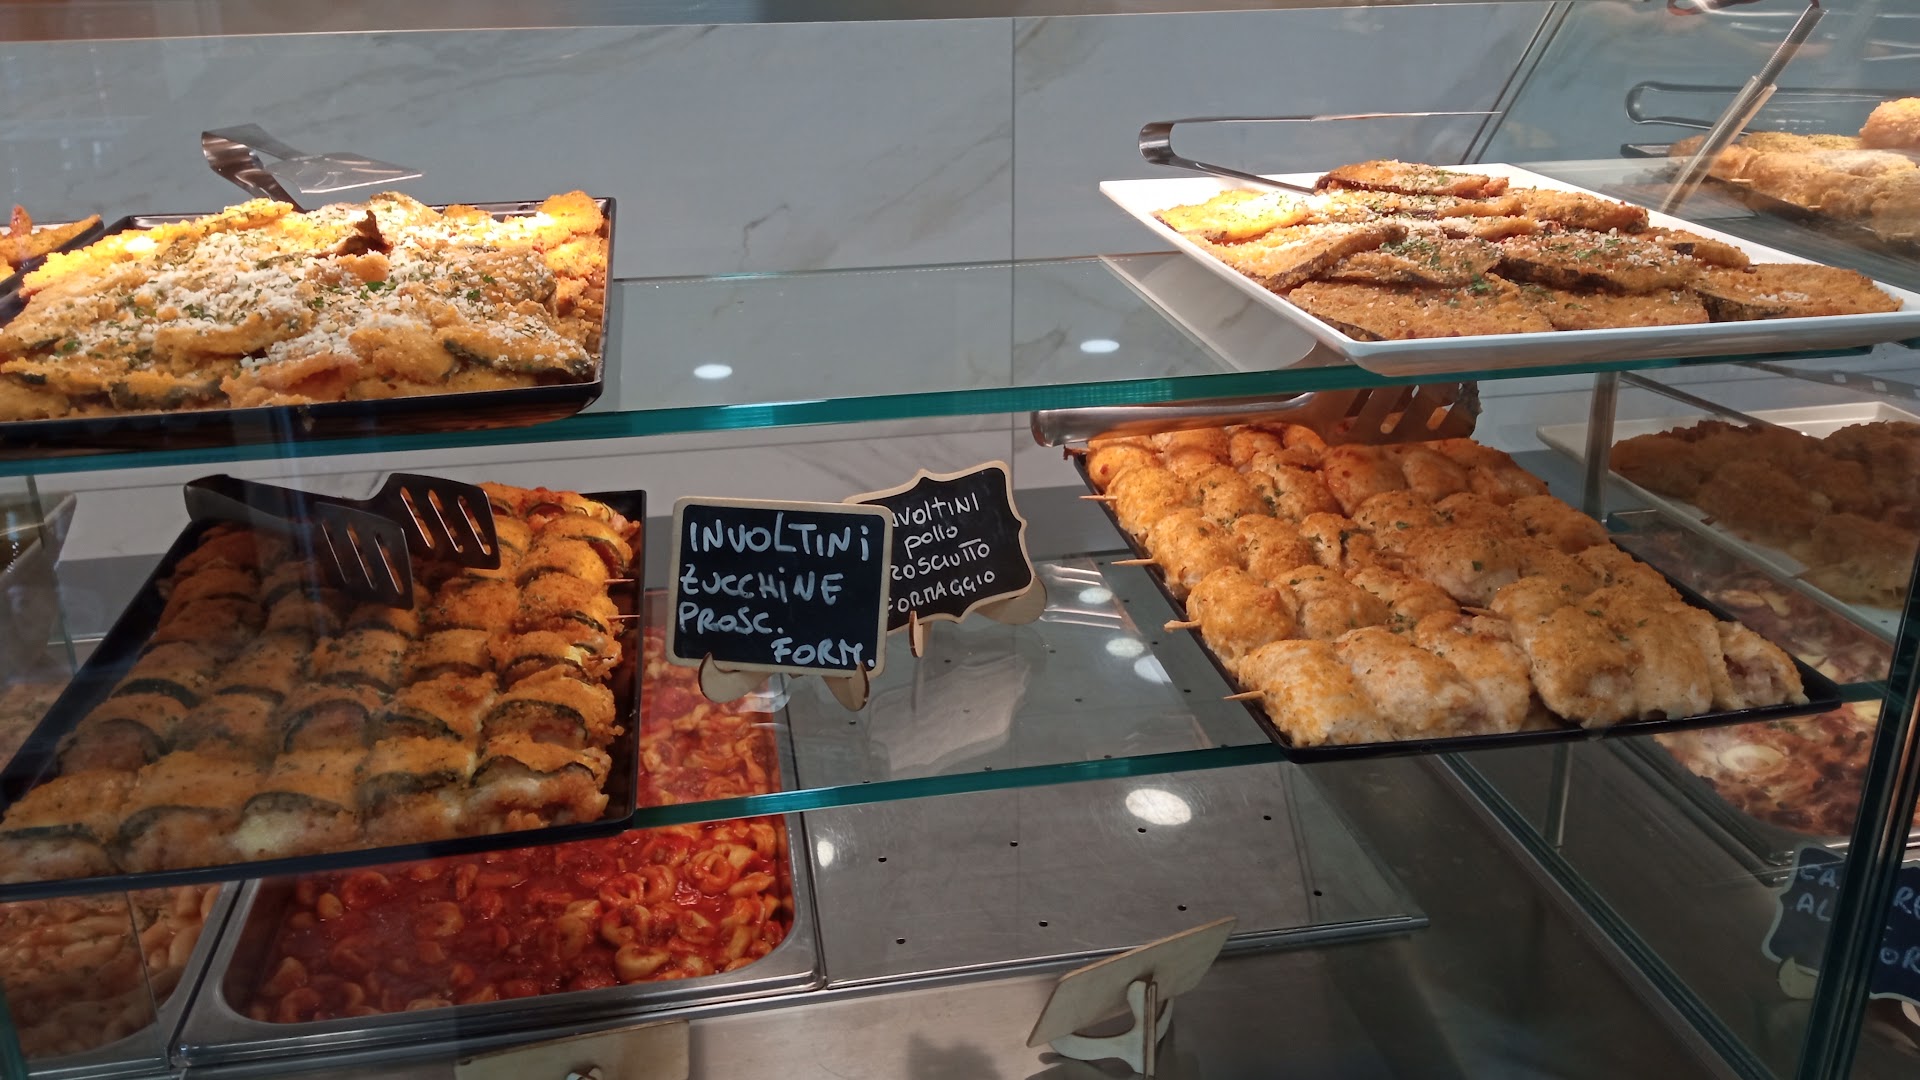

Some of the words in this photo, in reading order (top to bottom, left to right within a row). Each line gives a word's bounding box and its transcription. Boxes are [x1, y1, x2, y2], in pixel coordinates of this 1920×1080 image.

[689, 512, 869, 562] INVOLTINi
[890, 538, 991, 581] ROSCIUTTO
[679, 564, 844, 605] ZUCCHiNE
[678, 601, 784, 635] PROSC.
[770, 637, 876, 668] FORM.
